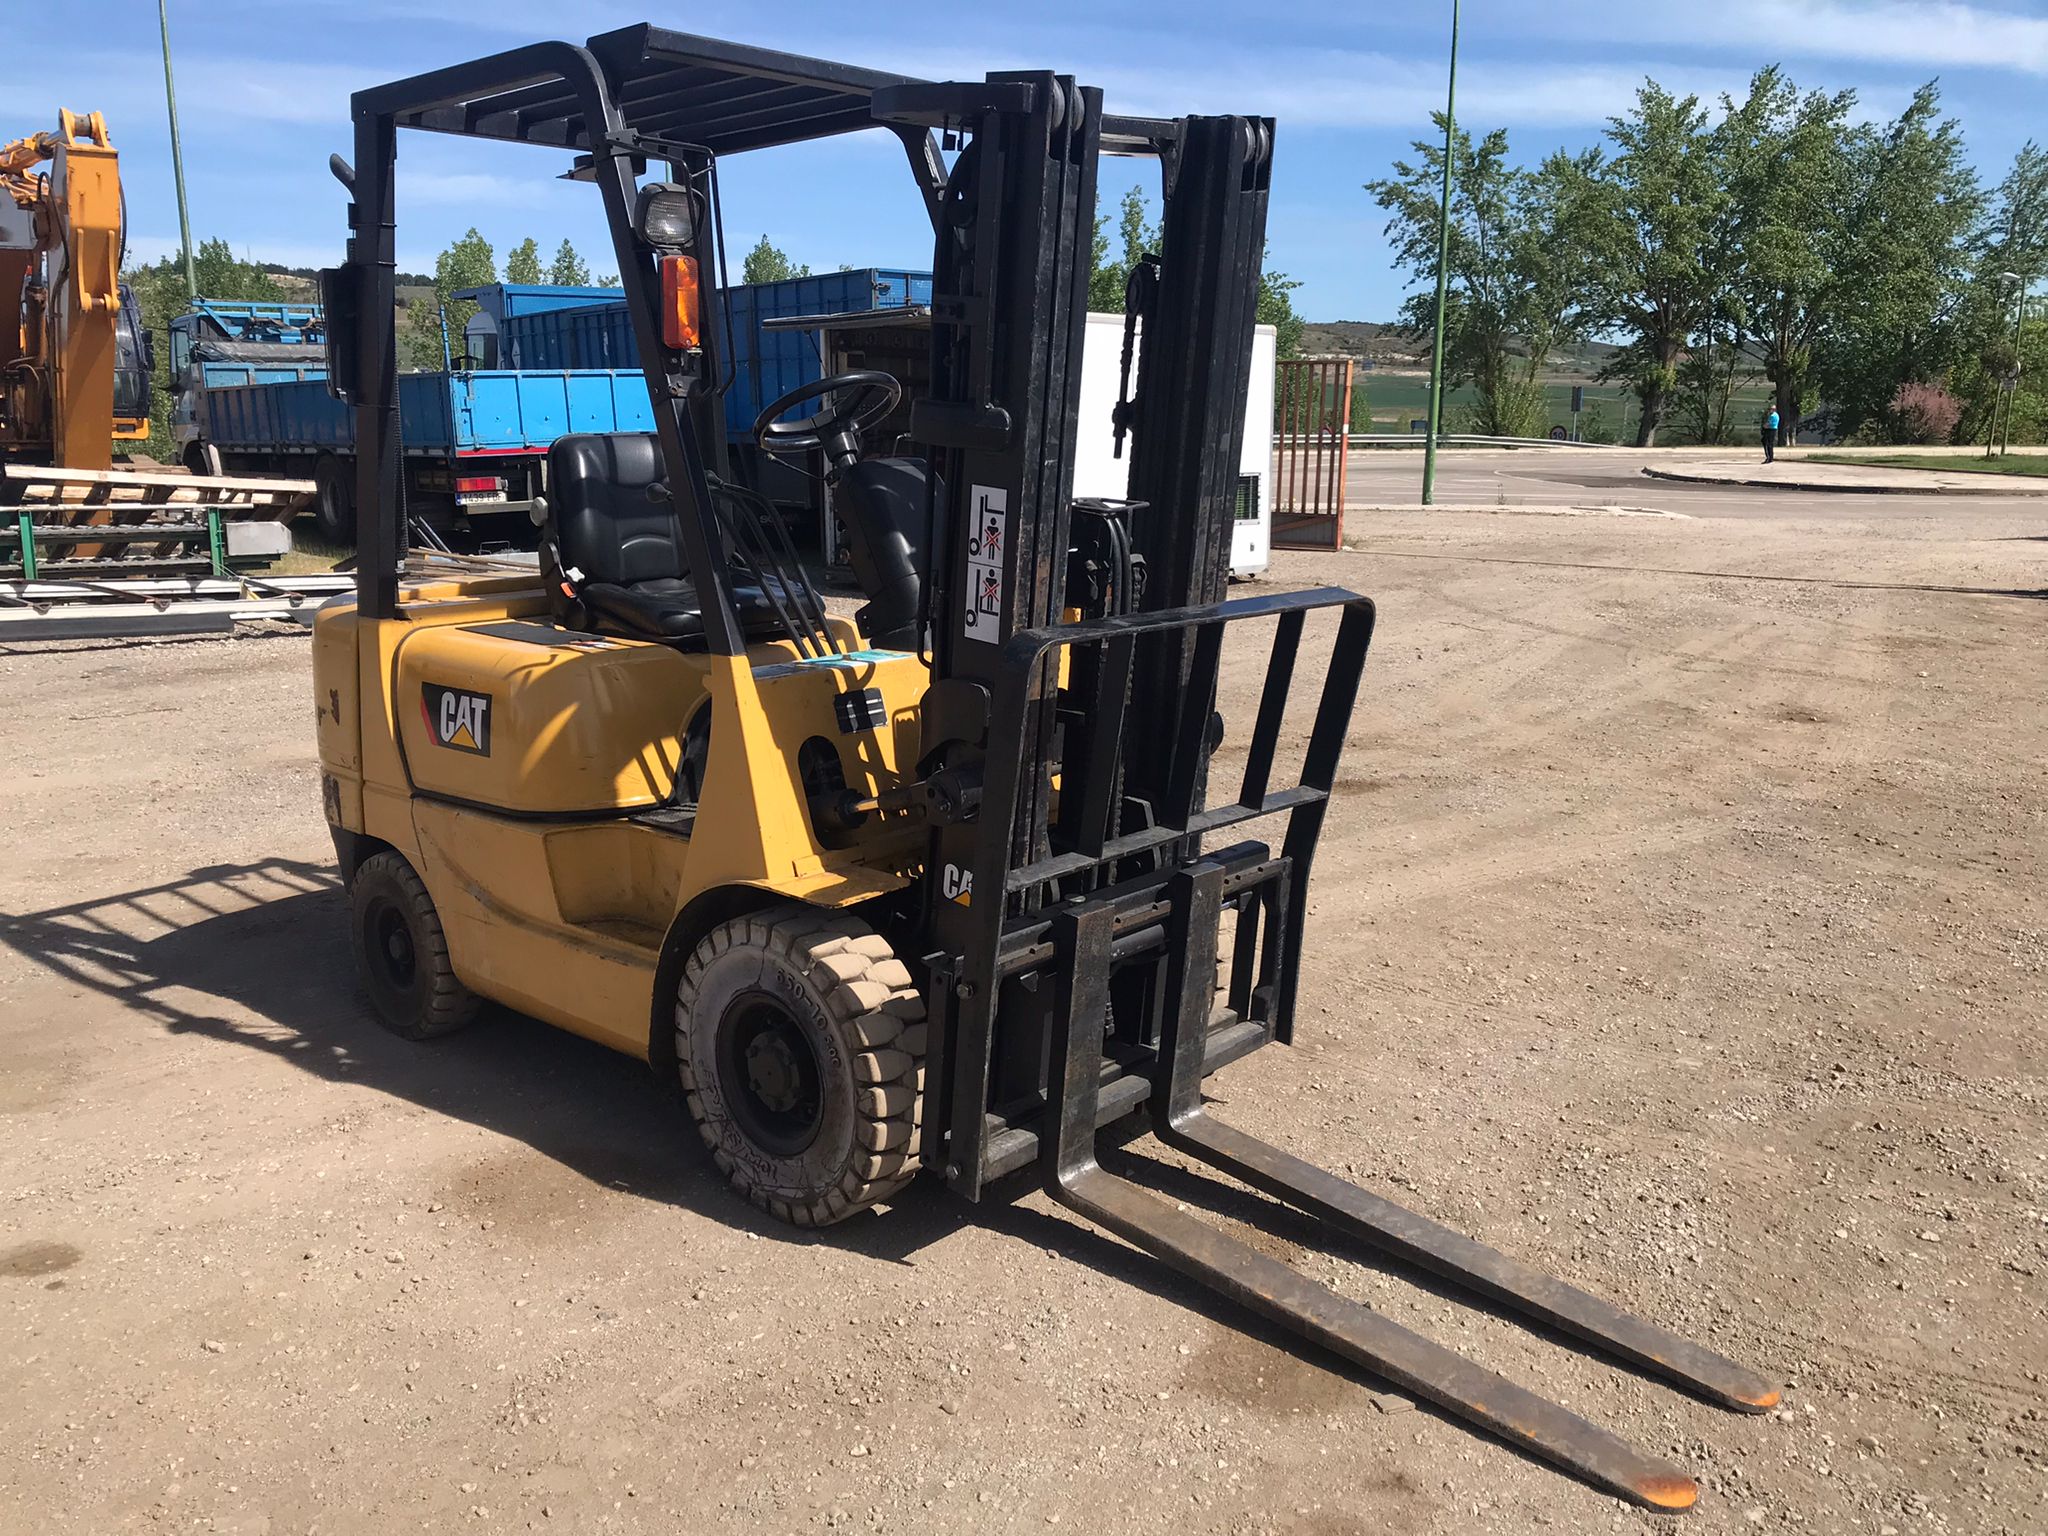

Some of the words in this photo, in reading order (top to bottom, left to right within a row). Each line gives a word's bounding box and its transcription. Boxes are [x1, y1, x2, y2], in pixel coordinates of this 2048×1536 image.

[440, 691, 487, 750] CAT
[943, 863, 974, 899] CA
[775, 967, 828, 1031] 650-10
